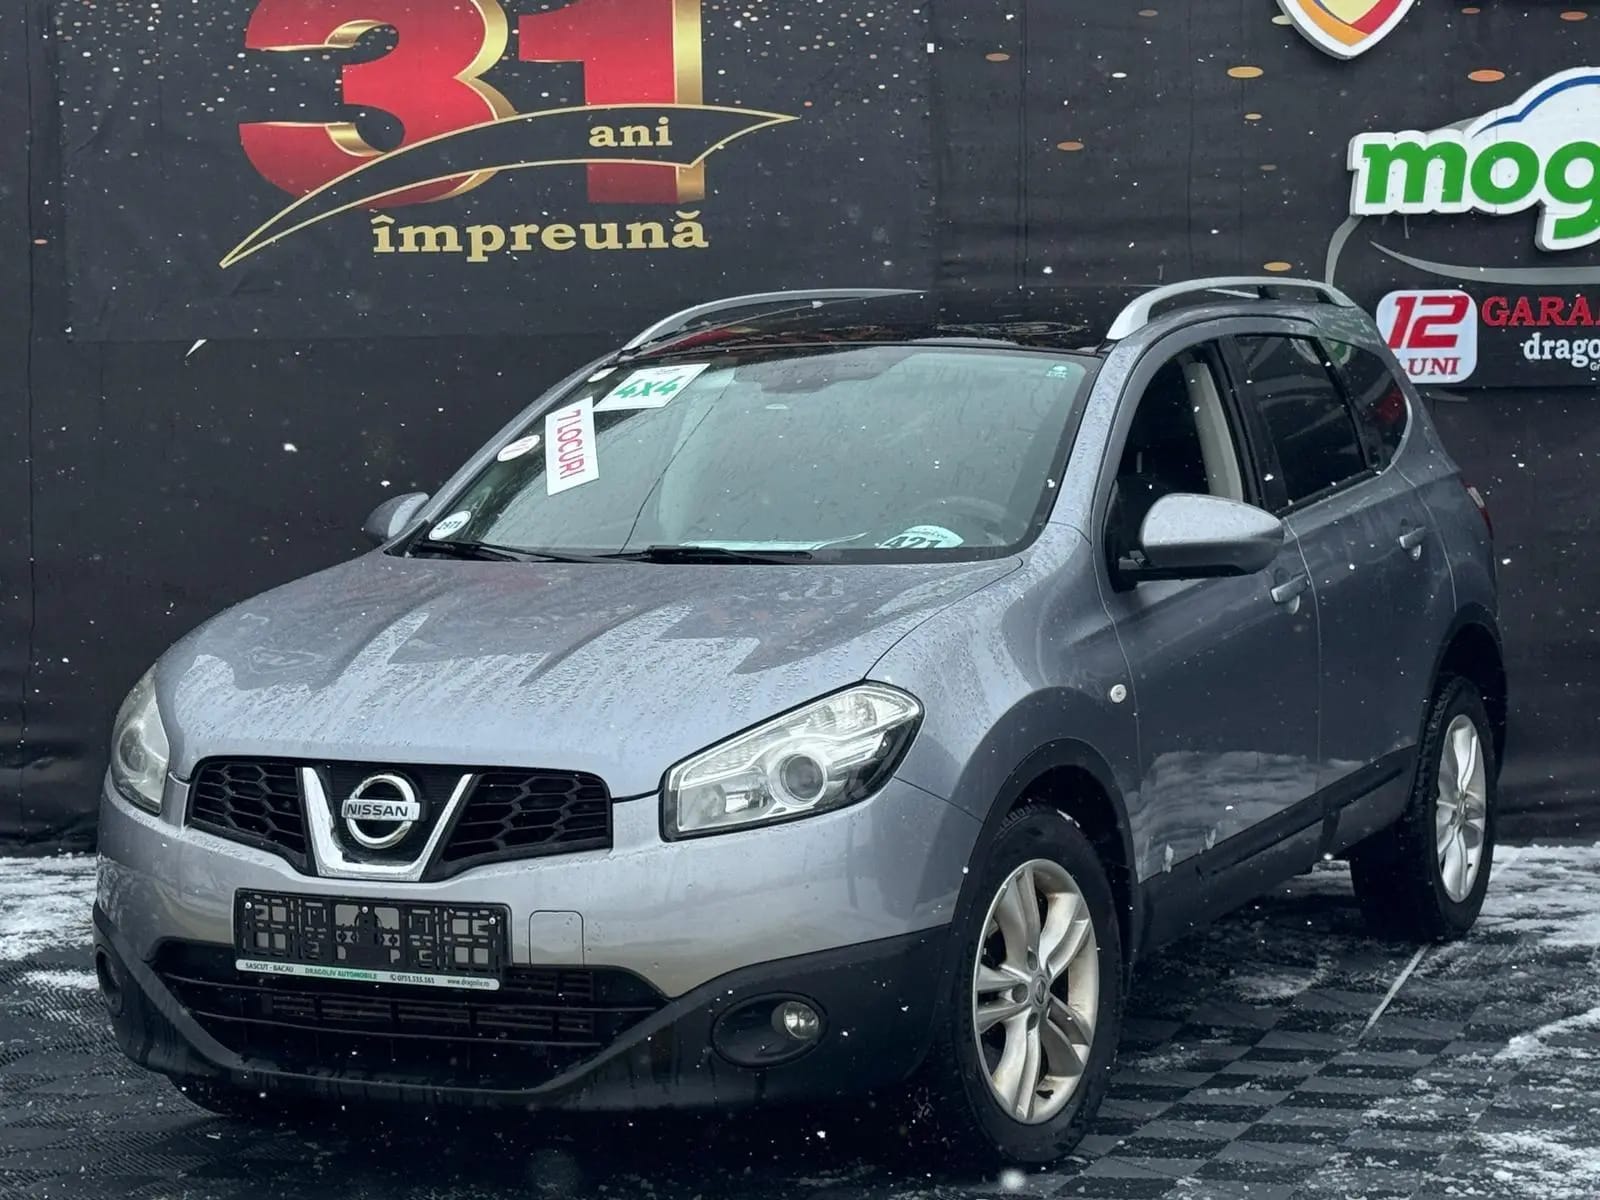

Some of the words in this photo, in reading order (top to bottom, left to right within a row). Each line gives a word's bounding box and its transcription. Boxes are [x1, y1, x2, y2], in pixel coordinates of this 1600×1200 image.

[239, 0, 706, 208] 31
[588, 116, 673, 147] ani
[1362, 140, 1600, 240] mog
[370, 210, 709, 262] împreună
[1388, 295, 1470, 349] 12
[1481, 296, 1600, 327] GARA
[1523, 332, 1600, 367] drago
[1401, 357, 1462, 377] UNI
[557, 409, 581, 421] 7
[557, 420, 585, 480] LOCURI
[347, 803, 408, 817] NISSAN
[245, 962, 268, 971] SASCUT
[304, 967, 337, 976] DRAGOLIV
[337, 970, 377, 980] AUTOMOBILE
